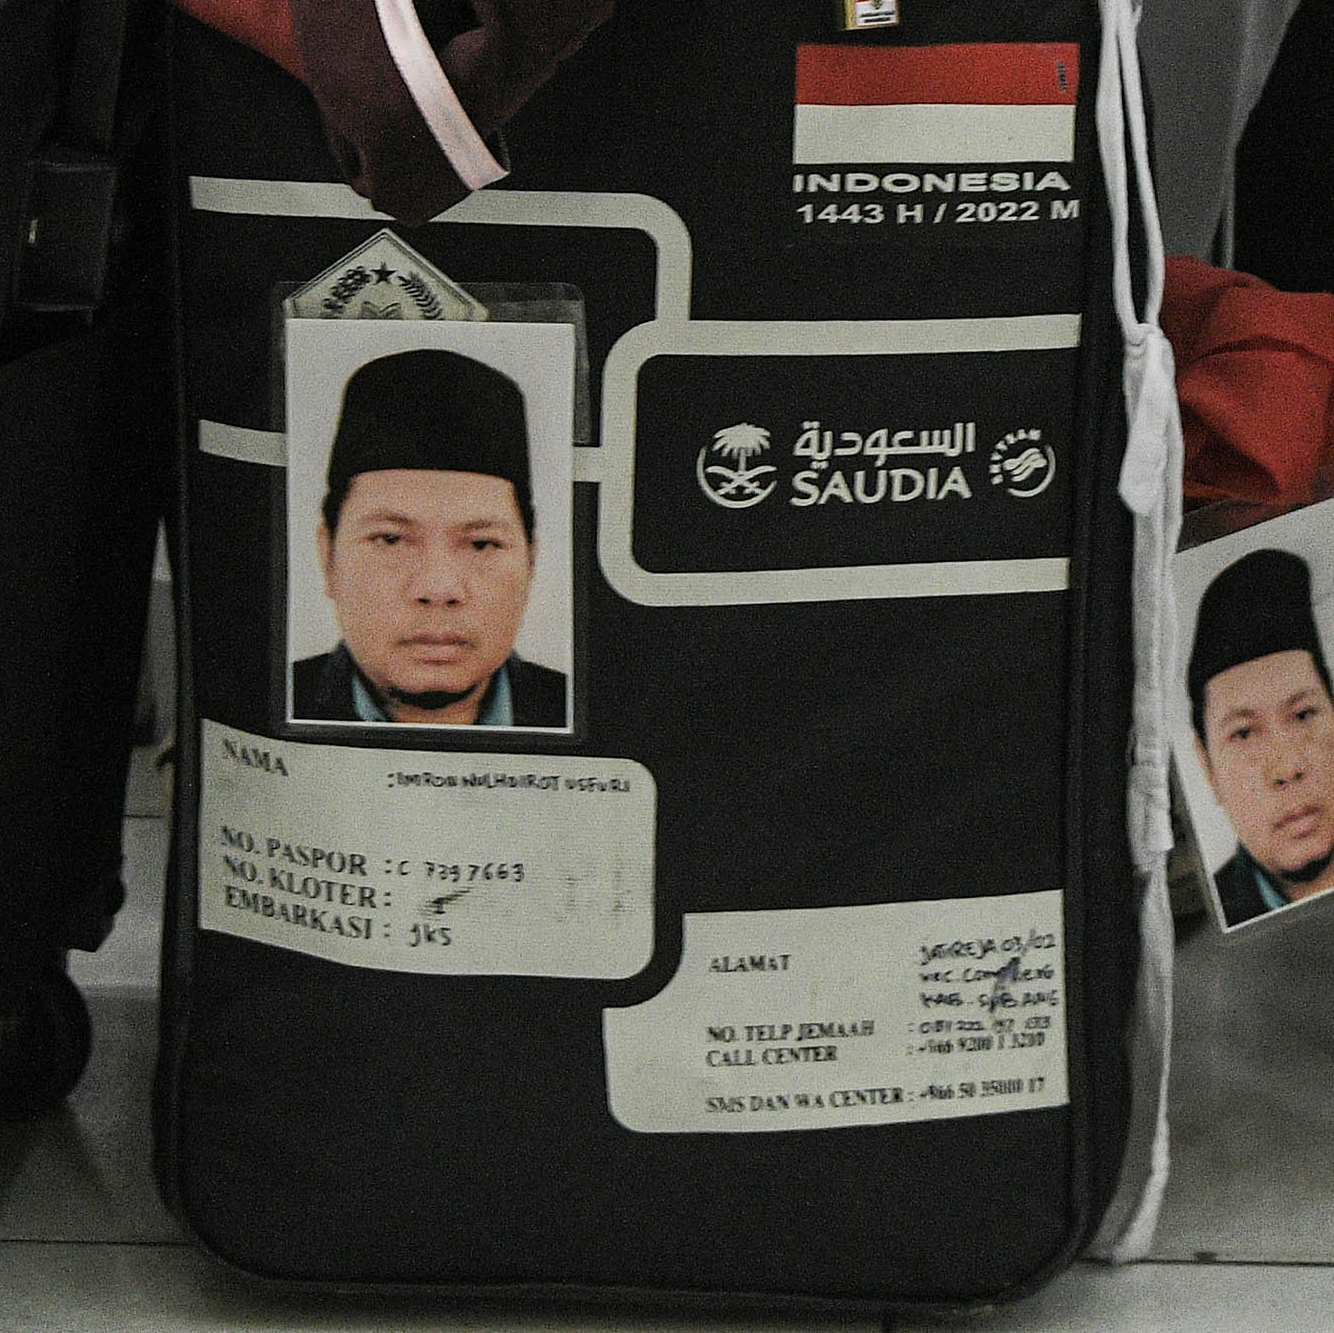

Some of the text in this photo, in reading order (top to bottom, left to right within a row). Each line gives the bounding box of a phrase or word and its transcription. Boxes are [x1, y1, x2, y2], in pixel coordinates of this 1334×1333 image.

[793, 171, 1071, 193] INDONESIA
[796, 199, 1080, 225] 1443 H / 2022 M
[793, 420, 976, 469] السعودية
[790, 466, 973, 508] SAUDIA
[222, 738, 289, 776] NAMA
[221, 825, 261, 854] NO.
[266, 837, 368, 877] PASPOR
[222, 855, 264, 885] NO.
[269, 867, 377, 909] KLOTER
[224, 885, 373, 940] EMBARKASI
[707, 954, 792, 973] ALAMAT
[744, 1024, 793, 1042] TELP
[796, 1020, 876, 1042] JEMAAH
[705, 1049, 756, 1068] CALL
[761, 1045, 838, 1066] CENTER
[705, 1096, 745, 1113] SMS
[749, 1094, 789, 1112] DAN
[793, 1093, 825, 1109] WA
[829, 1086, 904, 1108] CENTER
